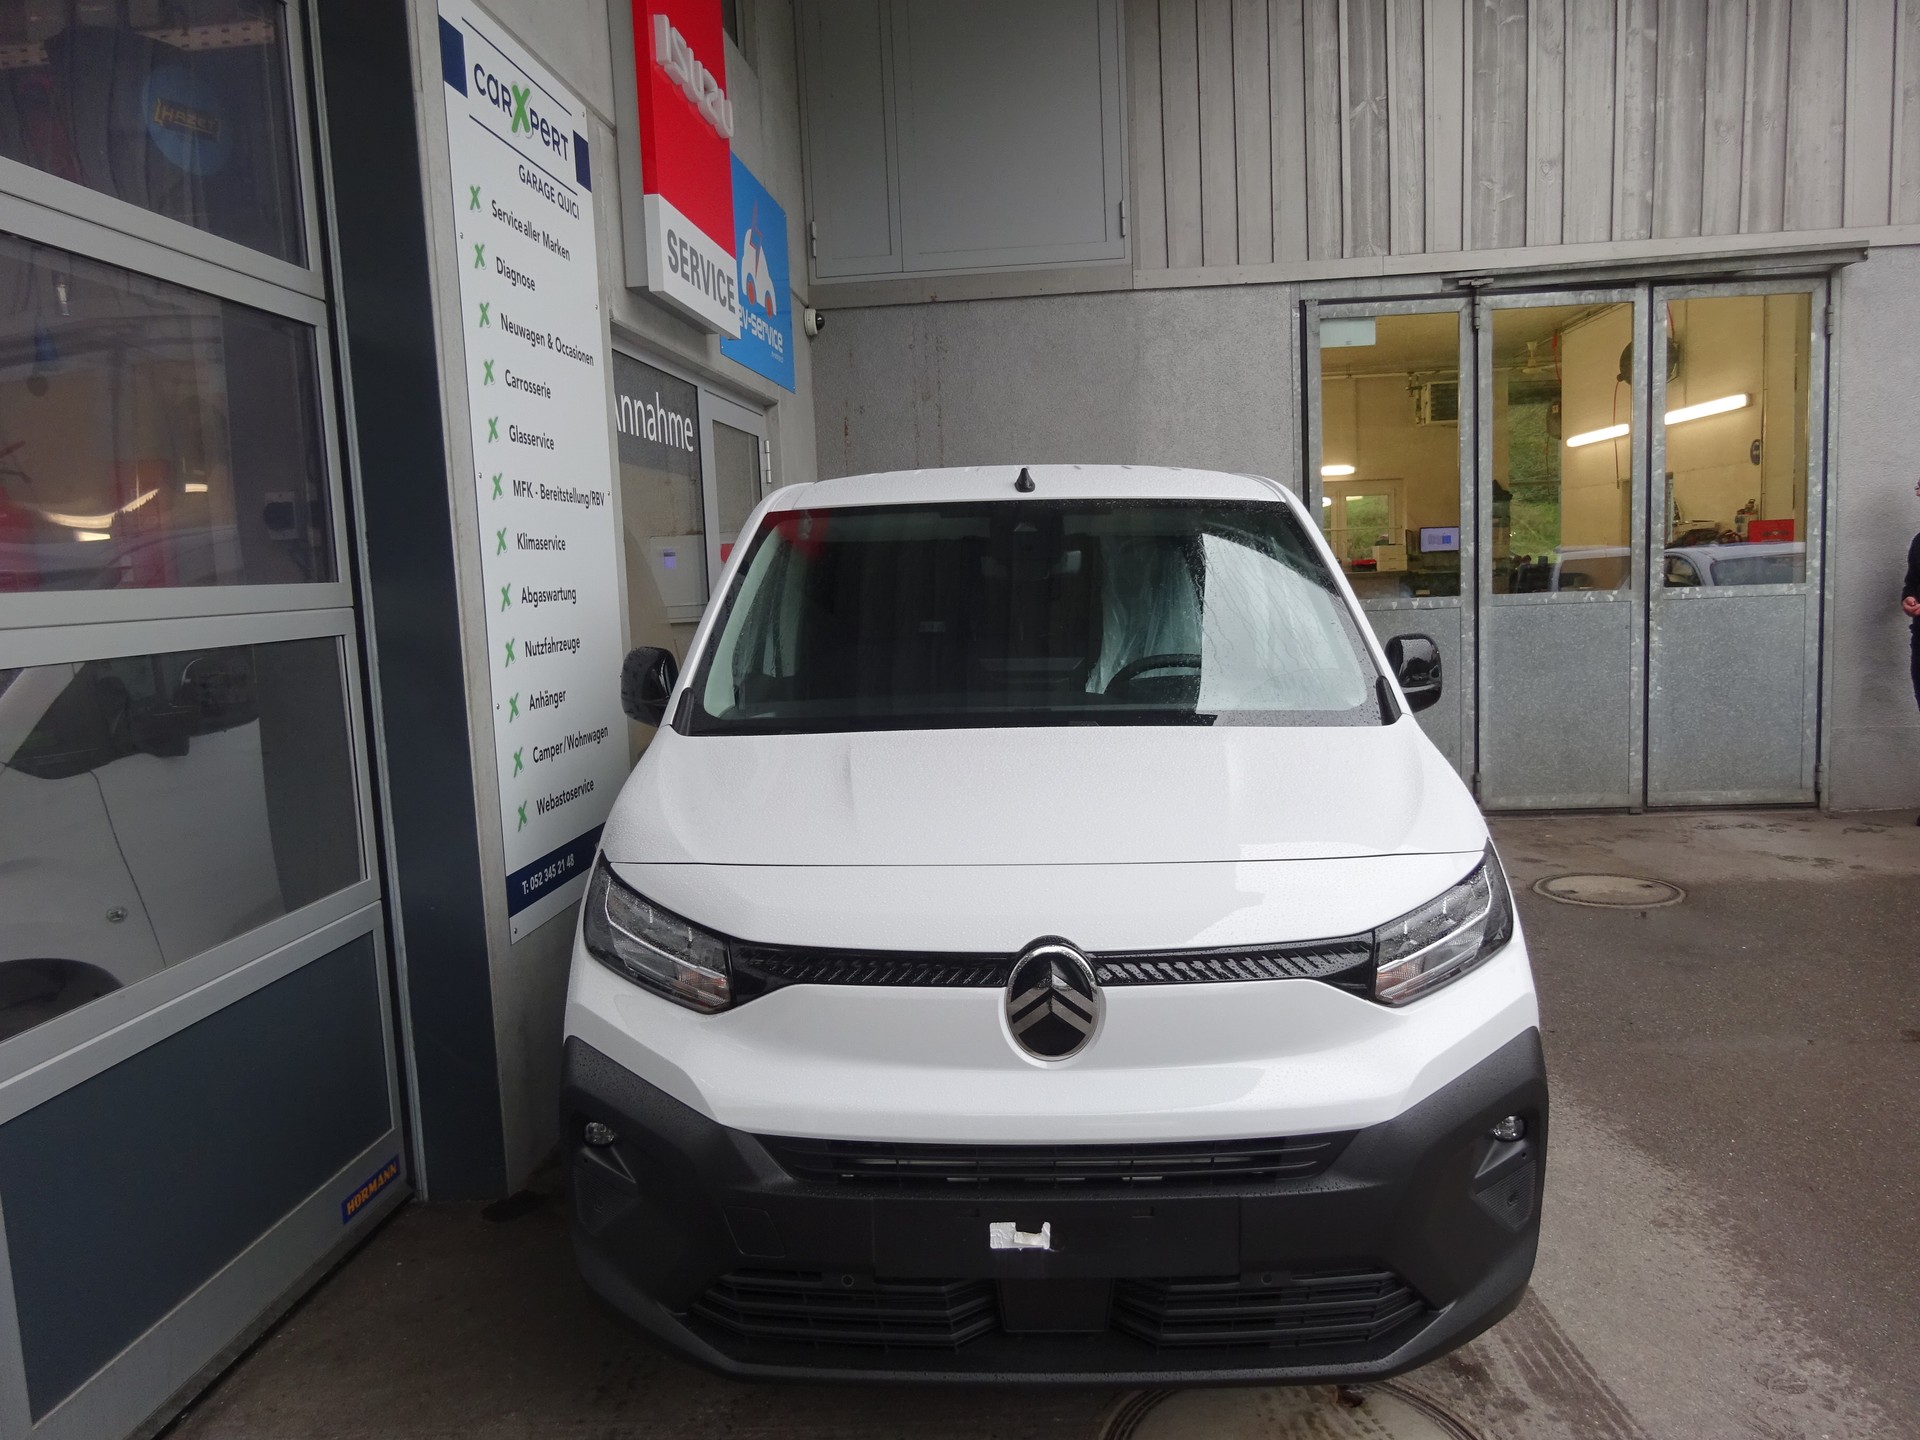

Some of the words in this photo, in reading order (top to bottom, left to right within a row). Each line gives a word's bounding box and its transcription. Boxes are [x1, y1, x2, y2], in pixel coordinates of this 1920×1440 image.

[518, 164, 556, 204] GARAGE
[491, 199, 523, 233] Service
[523, 220, 540, 244] aller
[542, 230, 571, 261] Marken
[496, 256, 536, 291] Diagnose
[666, 228, 736, 315] SERVICE
[500, 313, 546, 348] Neuwagen
[547, 332, 554, 350] &
[555, 336, 595, 367] Occasionen
[504, 369, 552, 399] Carrosserie
[509, 424, 555, 450] Glasservice
[512, 479, 534, 499] MFK
[540, 483, 605, 509] Bereitstellung/RBV
[516, 532, 566, 551] Klimaservice
[521, 586, 577, 608] Abgaswartung
[524, 636, 581, 658] Nutzfahrzeuge
[528, 689, 567, 711] Anhänger
[536, 778, 595, 816] Webastoservice
[521, 879, 529, 895] T:
[529, 871, 544, 891] 052
[543, 863, 557, 882] 345
[557, 858, 566, 875] 21
